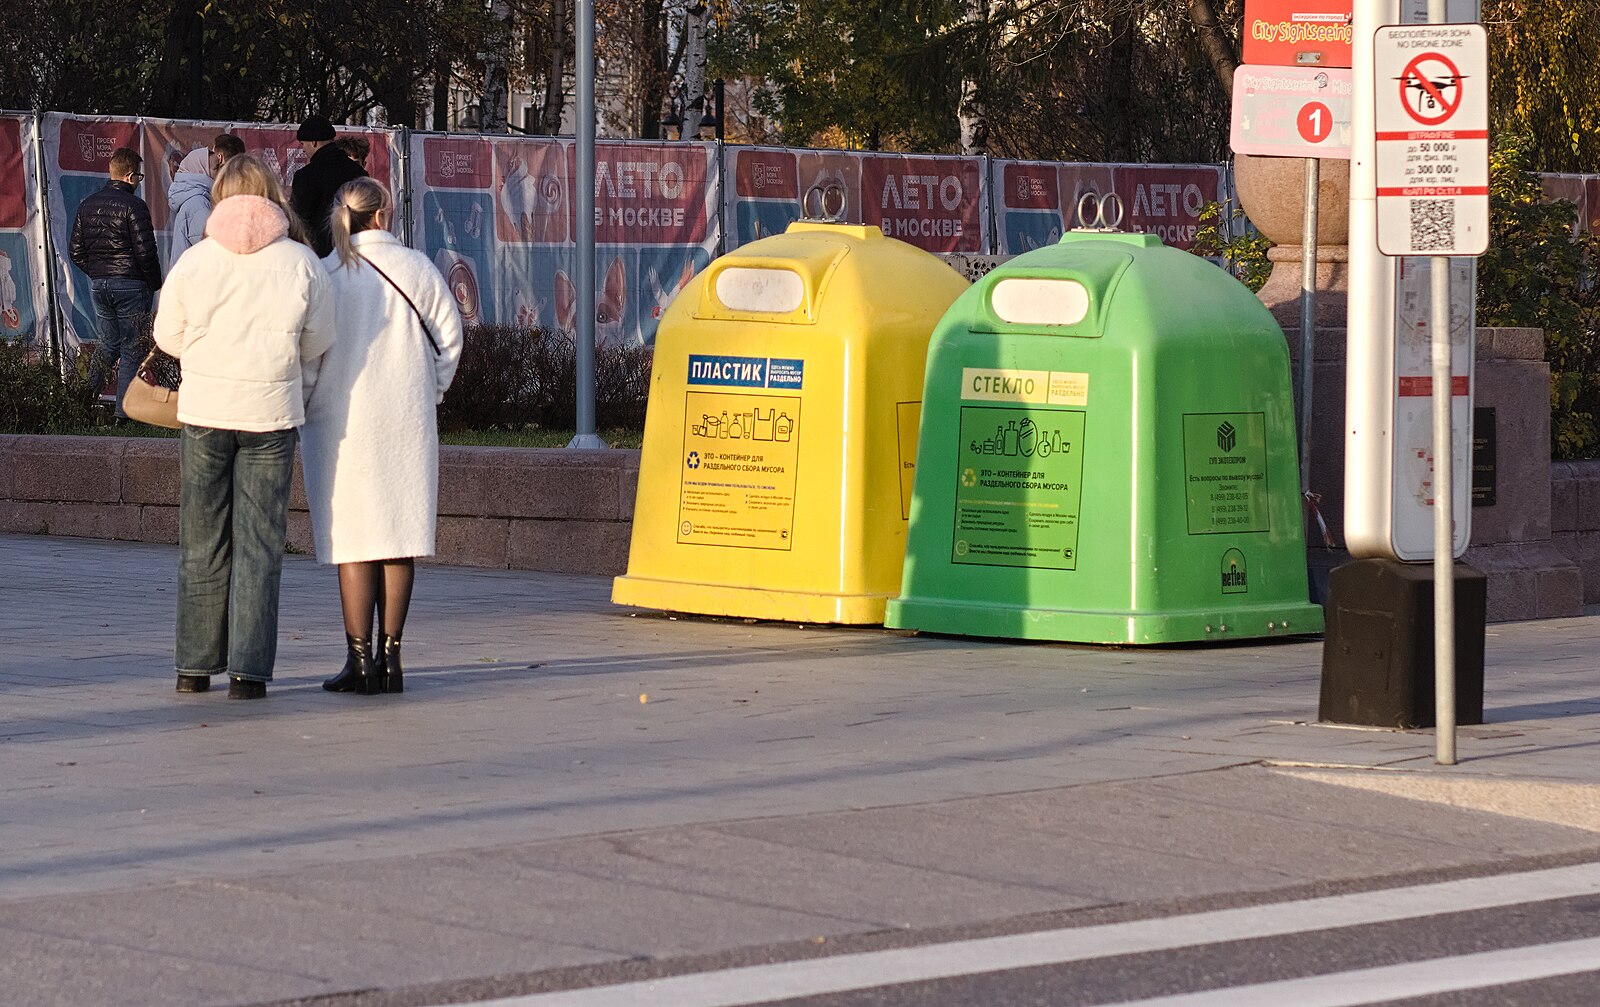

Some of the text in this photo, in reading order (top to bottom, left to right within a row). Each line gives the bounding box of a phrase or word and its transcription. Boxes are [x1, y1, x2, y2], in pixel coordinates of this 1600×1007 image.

[1252, 19, 1352, 45] City Sightseeing
[1388, 29, 1471, 39] БЕСПОЛЁТНАЯ ЗОНА
[1411, 40, 1439, 48] DRONE
[1441, 39, 1463, 47] ZONE
[1262, 76, 1319, 94] Sightseeing
[1309, 108, 1321, 136] 1
[1420, 142, 1431, 152] 50
[1433, 142, 1450, 152] 000
[1418, 164, 1433, 174] 300
[1436, 164, 1452, 174] 000
[594, 161, 684, 199] ЛЕТО
[881, 174, 963, 211] ЛЕТО
[1423, 187, 1436, 195] РФ
[1131, 183, 1204, 218] ЛЕТО
[609, 207, 684, 227] МОСКВЕ
[881, 217, 963, 237] В МОСКВЕ
[692, 361, 762, 381] ПЛАСТИК
[769, 375, 801, 383] РАЗДЕЛЬНО
[973, 375, 1034, 395] СТЕКЛО
[1051, 389, 1085, 398] РАЗДЕЛЬНО
[703, 452, 714, 460] ЭТО
[719, 453, 750, 462] КОНТЕЙНЕР
[751, 455, 763, 463] ДЛЯ
[703, 463, 741, 472] РАЗДЕЛЬНОГО
[761, 466, 785, 474] МУСОРА
[980, 469, 992, 477] ЭТО
[997, 470, 1032, 479] КОНТЕЙНЕР
[1032, 472, 1045, 480] ДЛЯ
[980, 480, 1020, 489] РАЗДЕЛЬНОГО
[1042, 483, 1068, 491] МУСОРА
